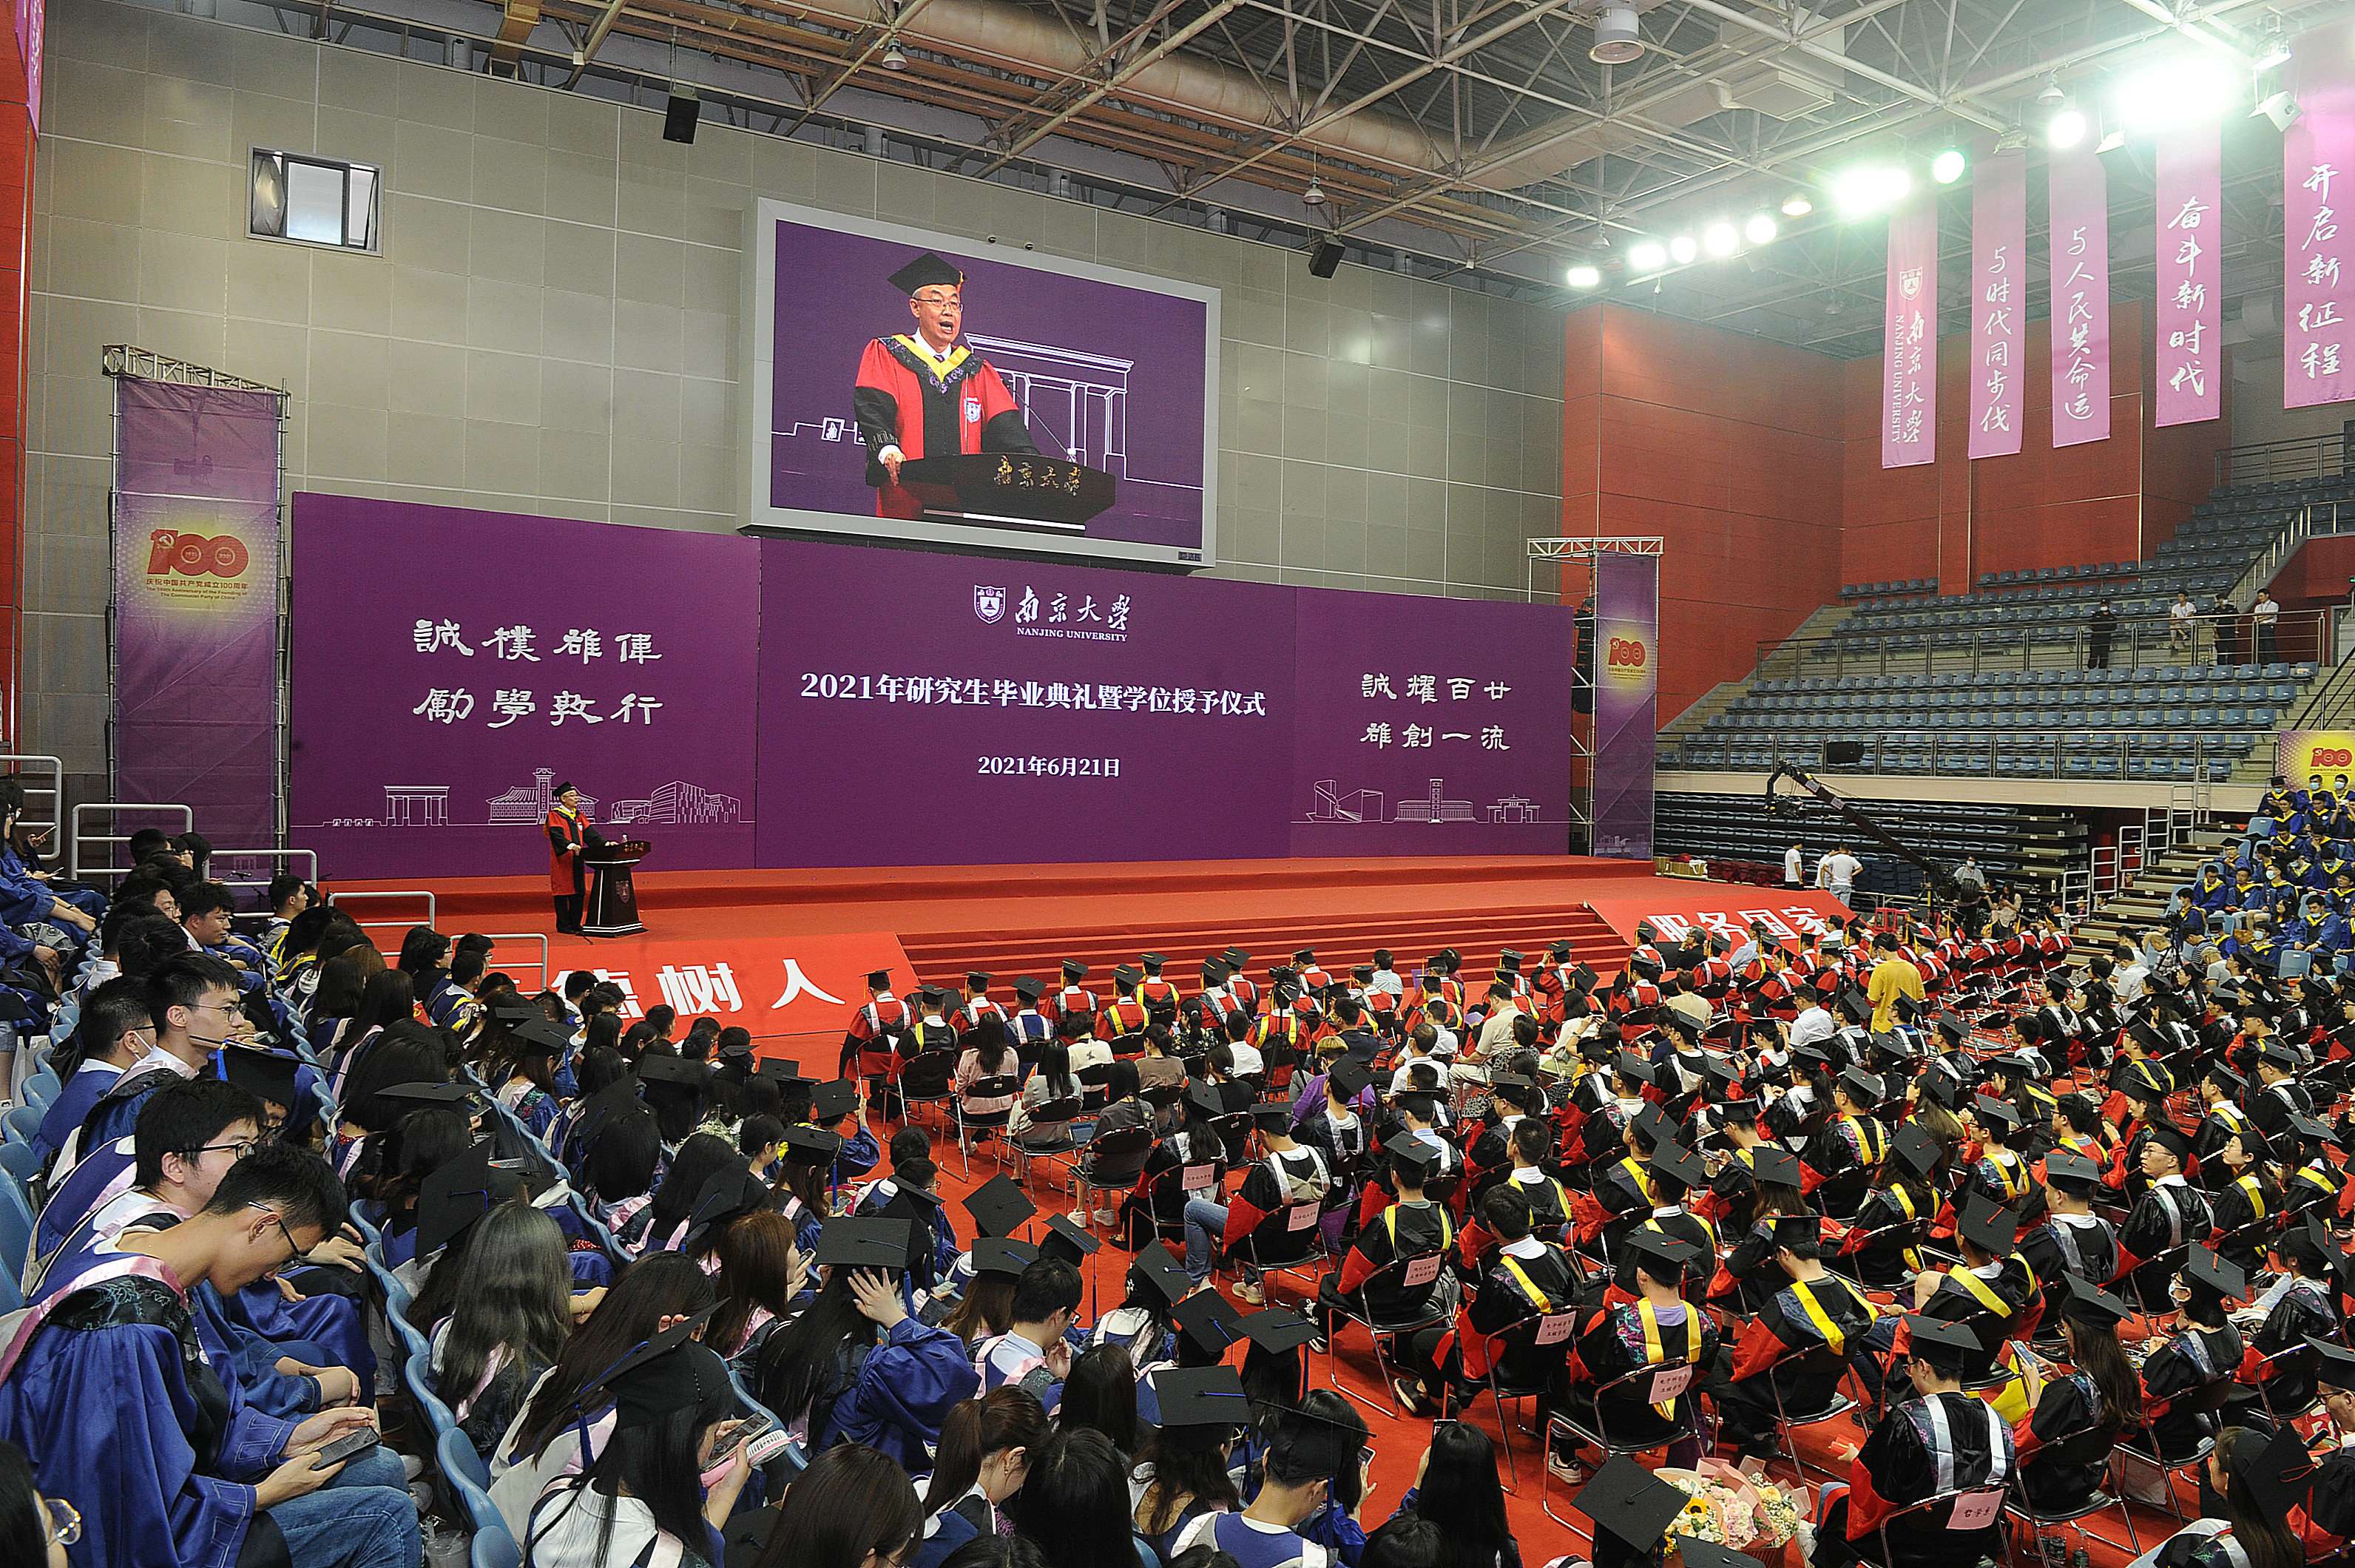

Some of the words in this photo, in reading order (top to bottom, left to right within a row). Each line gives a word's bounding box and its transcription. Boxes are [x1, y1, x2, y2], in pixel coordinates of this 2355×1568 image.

[2166, 195, 2210, 396] 奋斗新时代
[2299, 163, 2344, 379] 开启新征程
[1893, 315, 1905, 368] NANJING
[1980, 246, 2012, 433] 与时代同步伐
[2063, 226, 2096, 421] 与人民共命运
[1891, 372, 1903, 444] UNIVERSITY
[147, 529, 249, 578] 100
[1017, 627, 1064, 638] NANJING
[1067, 630, 1128, 642] UNIVERSITY
[1608, 637, 1646, 667] 100
[801, 673, 1266, 717] 2021年研究生毕业典礼暨学位授予仪式
[978, 755, 1120, 777] 2021年6月21日
[2311, 747, 2353, 767] 100
[1646, 906, 1830, 943] 服务国家
[513, 959, 845, 1018] 德树人
